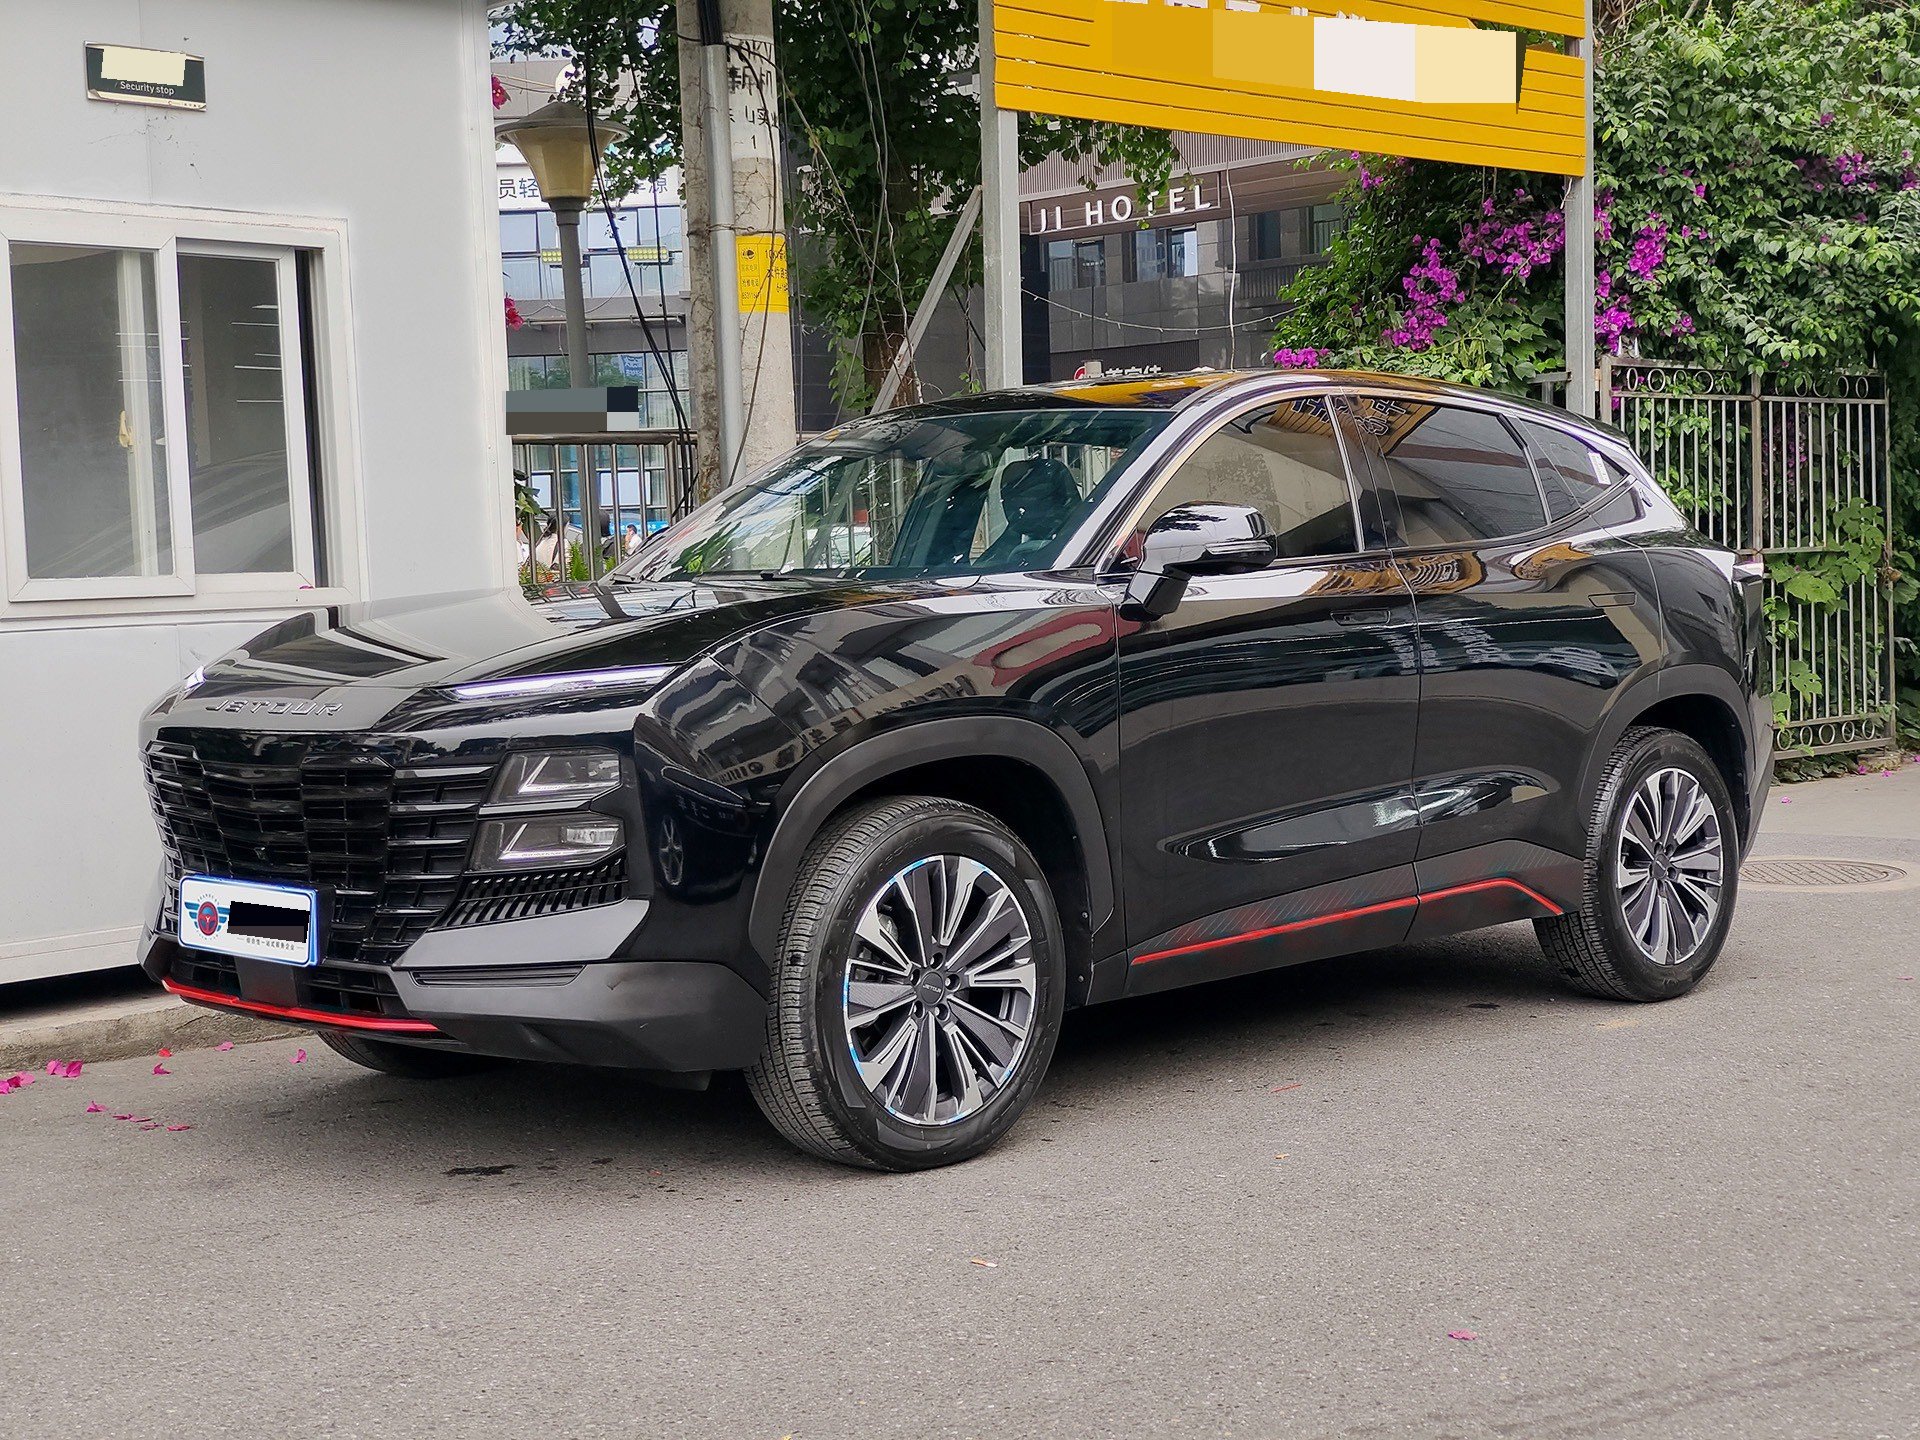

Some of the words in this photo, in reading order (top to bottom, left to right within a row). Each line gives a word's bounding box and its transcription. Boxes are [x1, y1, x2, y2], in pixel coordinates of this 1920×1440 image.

[120, 81, 155, 94] Security
[156, 84, 174, 96] stop
[1040, 204, 1063, 233] JI
[1085, 185, 1211, 226] HOTEL
[205, 699, 343, 717] JETOUR
